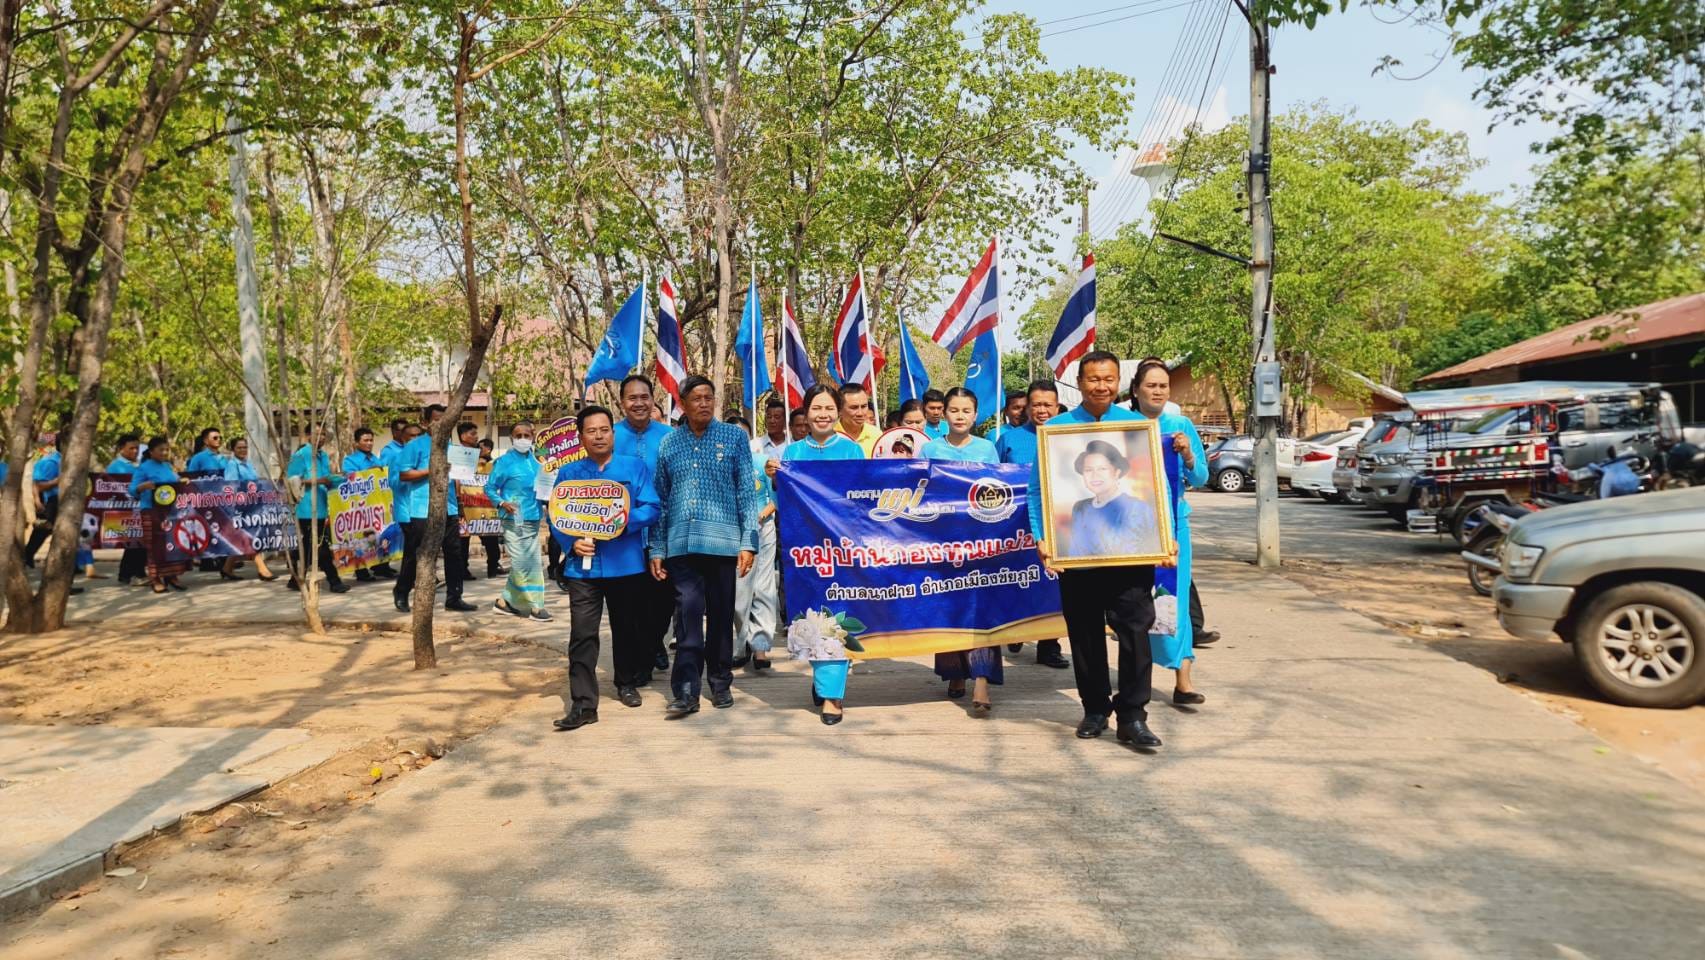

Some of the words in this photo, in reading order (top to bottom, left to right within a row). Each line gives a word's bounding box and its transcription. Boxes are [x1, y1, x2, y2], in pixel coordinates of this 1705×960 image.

[556, 483, 622, 499] ยาเสพติด
[564, 501, 609, 517] ดับชีวิต
[555, 516, 617, 534] ดับอนาคต
[826, 582, 916, 601] ตำบลนาฝาย
[921, 564, 1041, 596] อำเภอเมืองชัยภูมิ
